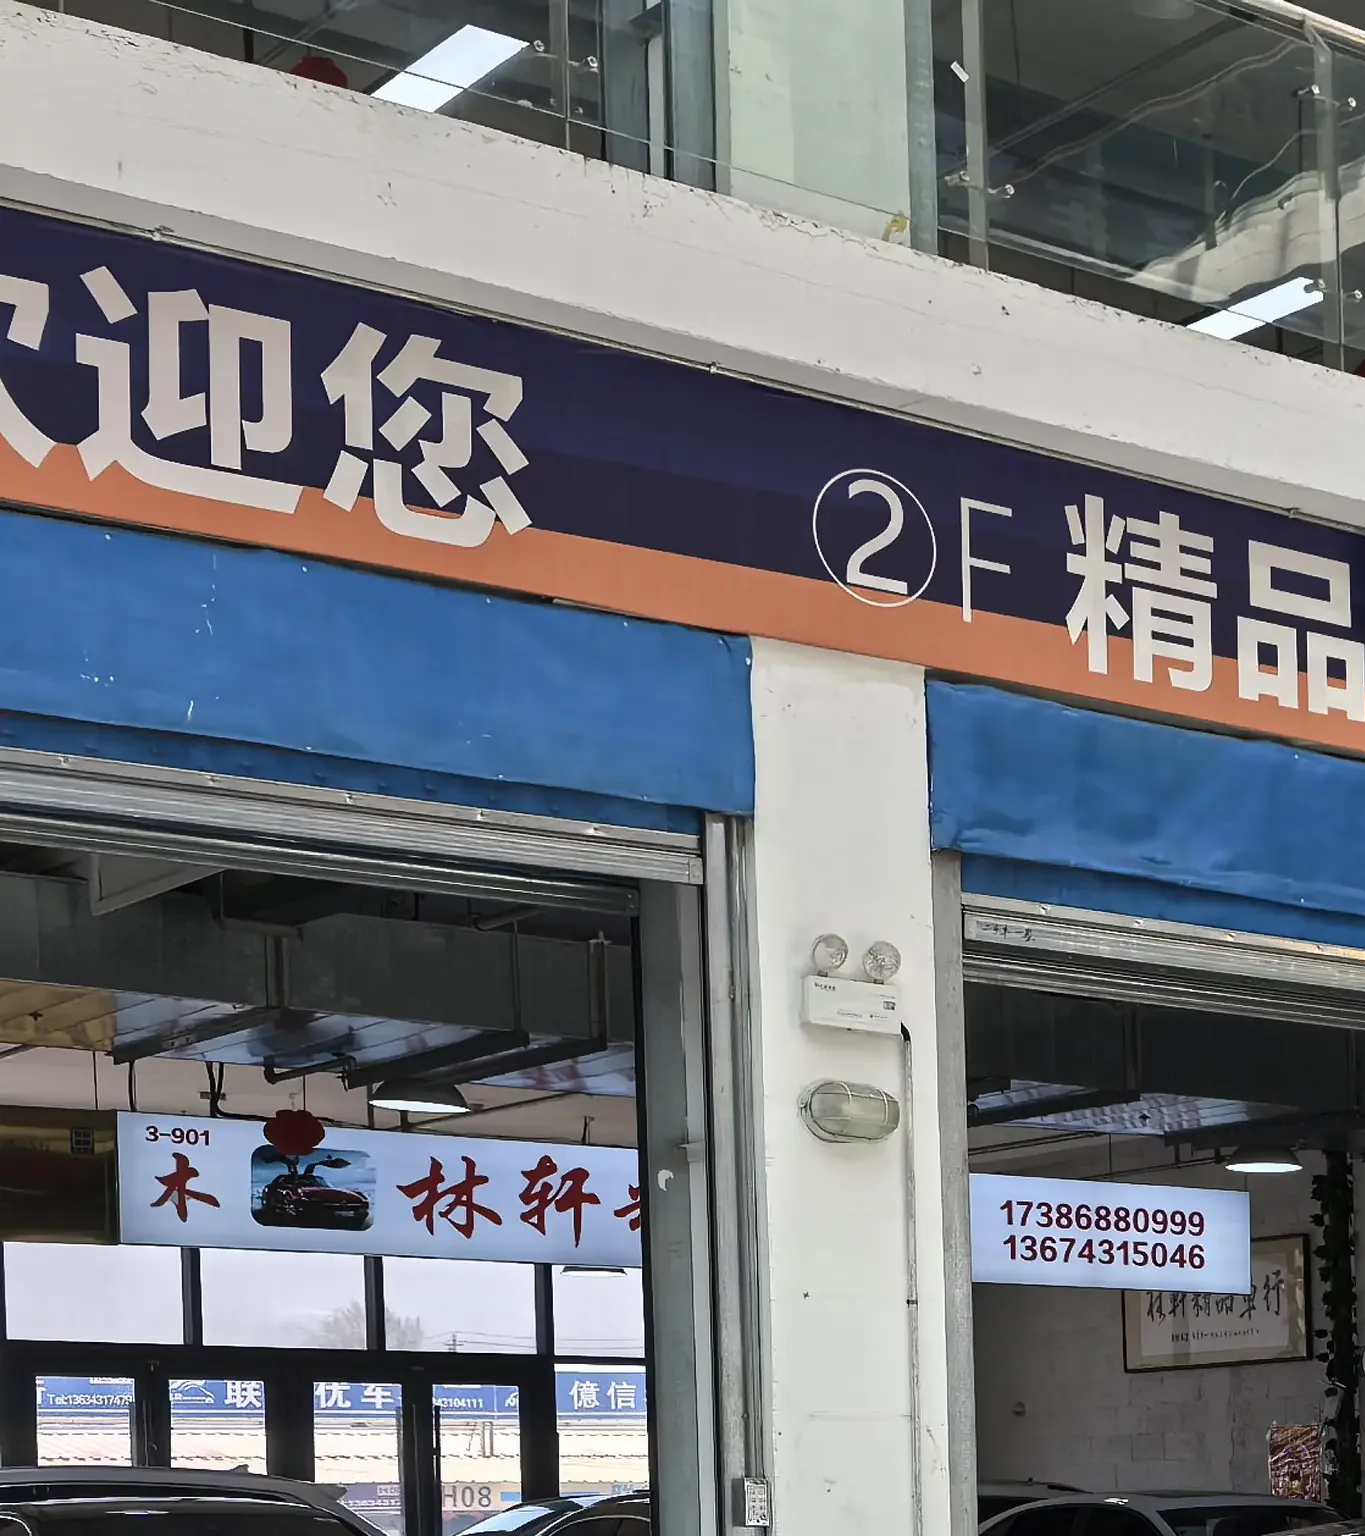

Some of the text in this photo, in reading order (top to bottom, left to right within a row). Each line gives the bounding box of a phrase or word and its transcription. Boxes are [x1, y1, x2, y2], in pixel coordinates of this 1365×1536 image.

[144, 1125, 211, 1146] 3-901
[150, 1152, 221, 1222] 木
[999, 1199, 1206, 1237] 17386880999
[1003, 1234, 1206, 1271] 13674315046
